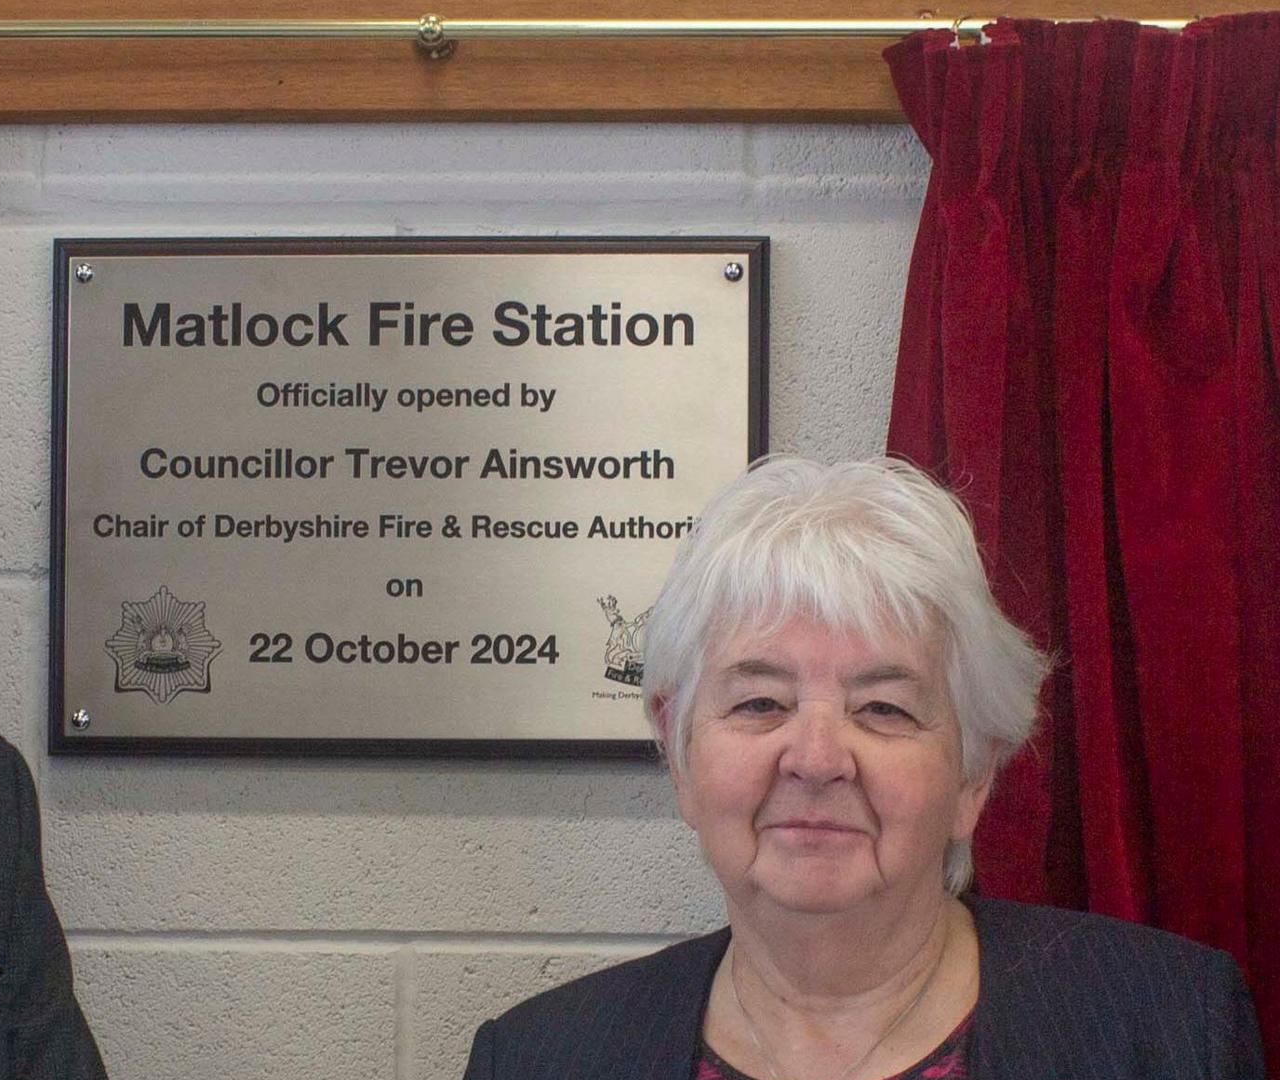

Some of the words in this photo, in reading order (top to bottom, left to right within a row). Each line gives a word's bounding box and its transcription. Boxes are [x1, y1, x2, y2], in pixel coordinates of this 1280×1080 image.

[123, 302, 350, 348] Matlock
[369, 301, 474, 347] Fire
[492, 300, 695, 347] Station
[256, 382, 388, 413] Officially
[397, 382, 510, 413] opened
[520, 382, 557, 413] by
[140, 447, 335, 479] Councillor
[344, 448, 470, 479] Trevor
[479, 448, 675, 480] Ainsworth
[93, 513, 170, 538] Chair
[177, 514, 206, 538] of
[214, 514, 370, 545] Derbyshire
[379, 514, 433, 539] Fire
[441, 514, 462, 539] &
[471, 514, 579, 539] Rescue
[587, 515, 702, 540] Authori
[385, 578, 423, 598] on
[249, 632, 293, 663] 22
[304, 632, 460, 664] October
[470, 633, 560, 665] 2024
